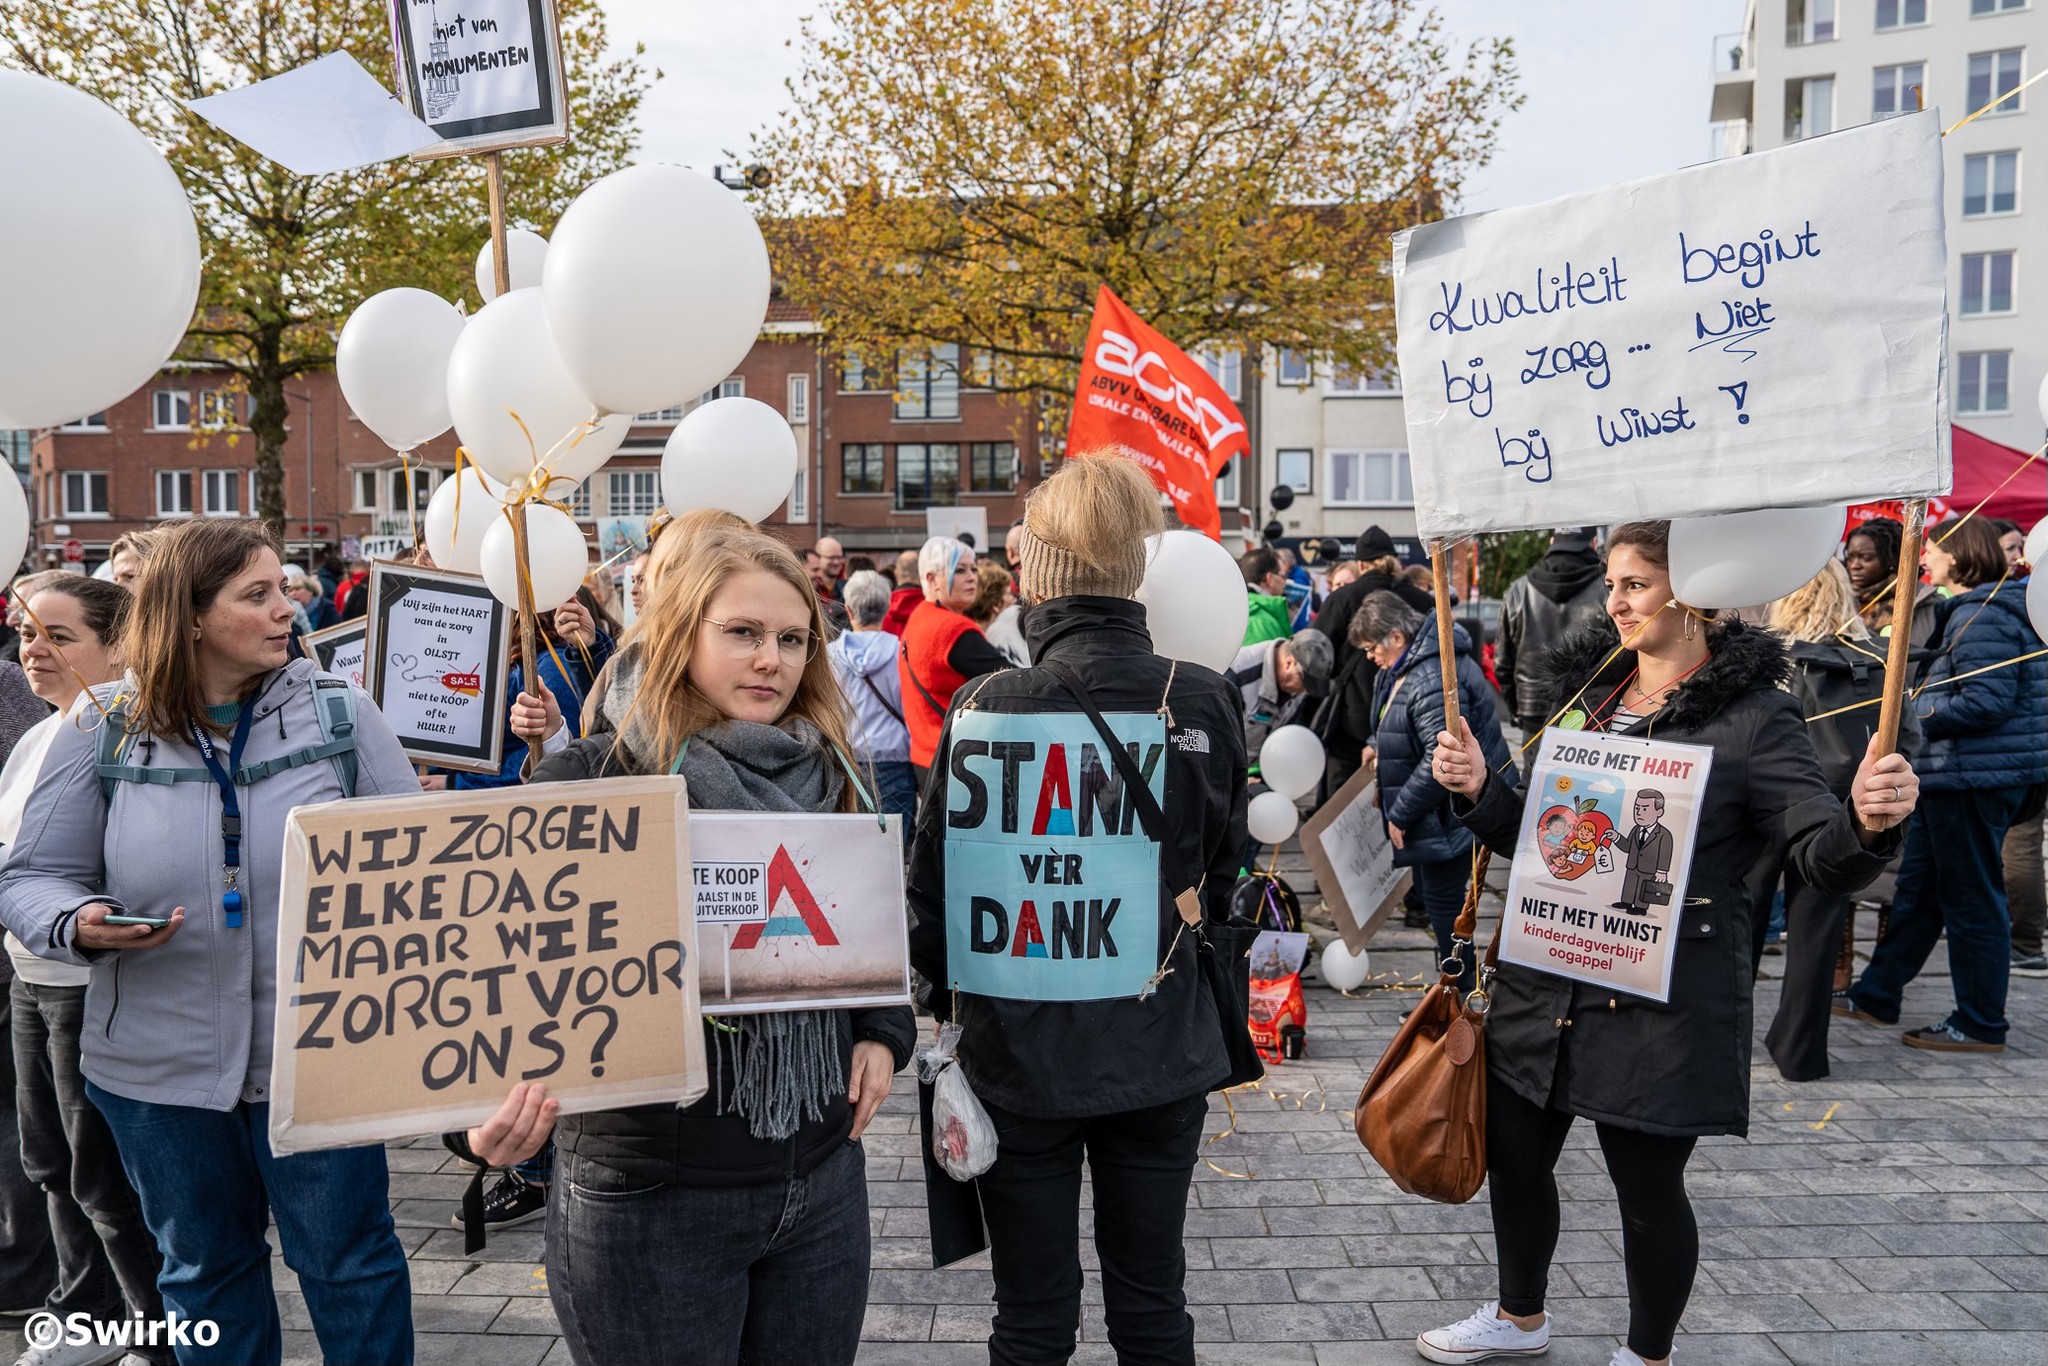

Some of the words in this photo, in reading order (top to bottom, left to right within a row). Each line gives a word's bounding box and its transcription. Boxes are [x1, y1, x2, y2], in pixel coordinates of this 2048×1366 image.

[436, 13, 466, 40] niet
[471, 19, 498, 34] van
[422, 46, 529, 80] MONUMENTEN
[1429, 257, 1627, 334] Kwaliteit
[1680, 221, 1821, 288] begint
[1696, 298, 1776, 340] Niet
[1091, 375, 1131, 396] ABVV
[1597, 396, 1696, 448] Winst
[364, 540, 404, 556] PITTA
[402, 598, 421, 612] Wij
[421, 602, 442, 615] zijn
[443, 606, 459, 615] het
[460, 607, 490, 620] HART
[414, 617, 433, 625] van
[434, 619, 447, 629] de
[448, 623, 473, 634] zorg
[437, 634, 447, 644] in
[336, 654, 361, 669] Waar
[450, 676, 478, 687] SALE
[408, 691, 427, 702] niet
[429, 692, 439, 703] te
[440, 695, 469, 707] KOOP
[416, 721, 446, 734] HUUR
[448, 725, 456, 735] !!
[1170, 735, 1200, 744] NORTH
[1183, 728, 1200, 737] THE
[1179, 743, 1200, 751] FACE
[1552, 745, 1600, 766] ZORG
[1603, 752, 1641, 772] MET
[1642, 757, 1693, 779] HART
[948, 739, 1165, 837] STANK
[309, 826, 428, 876] WIJ
[429, 805, 641, 864] ZORGEN
[715, 867, 760, 885] KOOP
[306, 874, 446, 934] ELKE
[460, 863, 580, 918] DAG
[697, 891, 729, 903] AALST
[731, 891, 742, 902] IN
[744, 890, 757, 902] DE
[970, 896, 1121, 959] DANK
[1520, 897, 1559, 920] NIET
[1562, 907, 1598, 929] MET
[1603, 914, 1662, 944] WINST
[294, 923, 469, 983] MAAR
[495, 901, 619, 961] WIE
[1523, 922, 1646, 962] kinderdagverblijf
[1548, 947, 1613, 971] oogappel
[289, 964, 517, 1050] ZORGT
[525, 940, 687, 1017] VOOR
